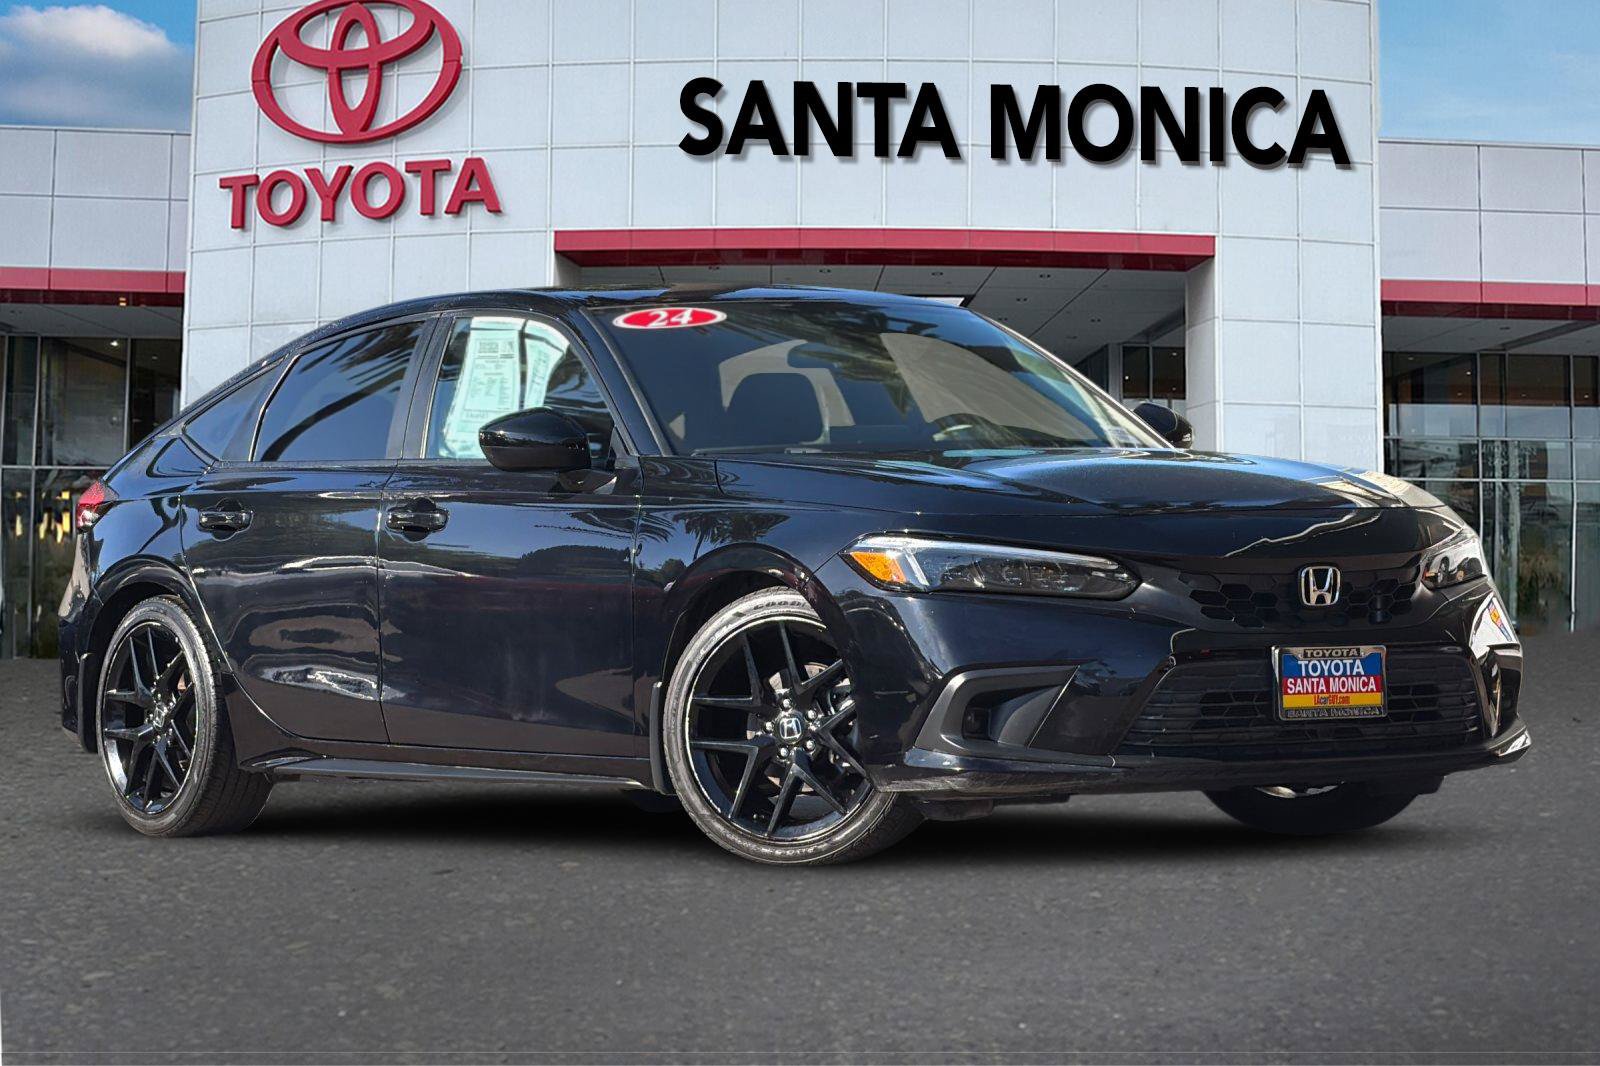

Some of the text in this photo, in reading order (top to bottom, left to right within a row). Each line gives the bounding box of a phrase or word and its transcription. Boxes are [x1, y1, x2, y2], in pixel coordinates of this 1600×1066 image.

[678, 77, 1351, 167] SANTA MONICA
[219, 157, 502, 229] TOYOTA
[647, 308, 693, 327] 24
[1304, 648, 1358, 658] TOYOTA
[1297, 659, 1365, 676] TOYOTA
[1287, 676, 1376, 694] SANTA MONICA
